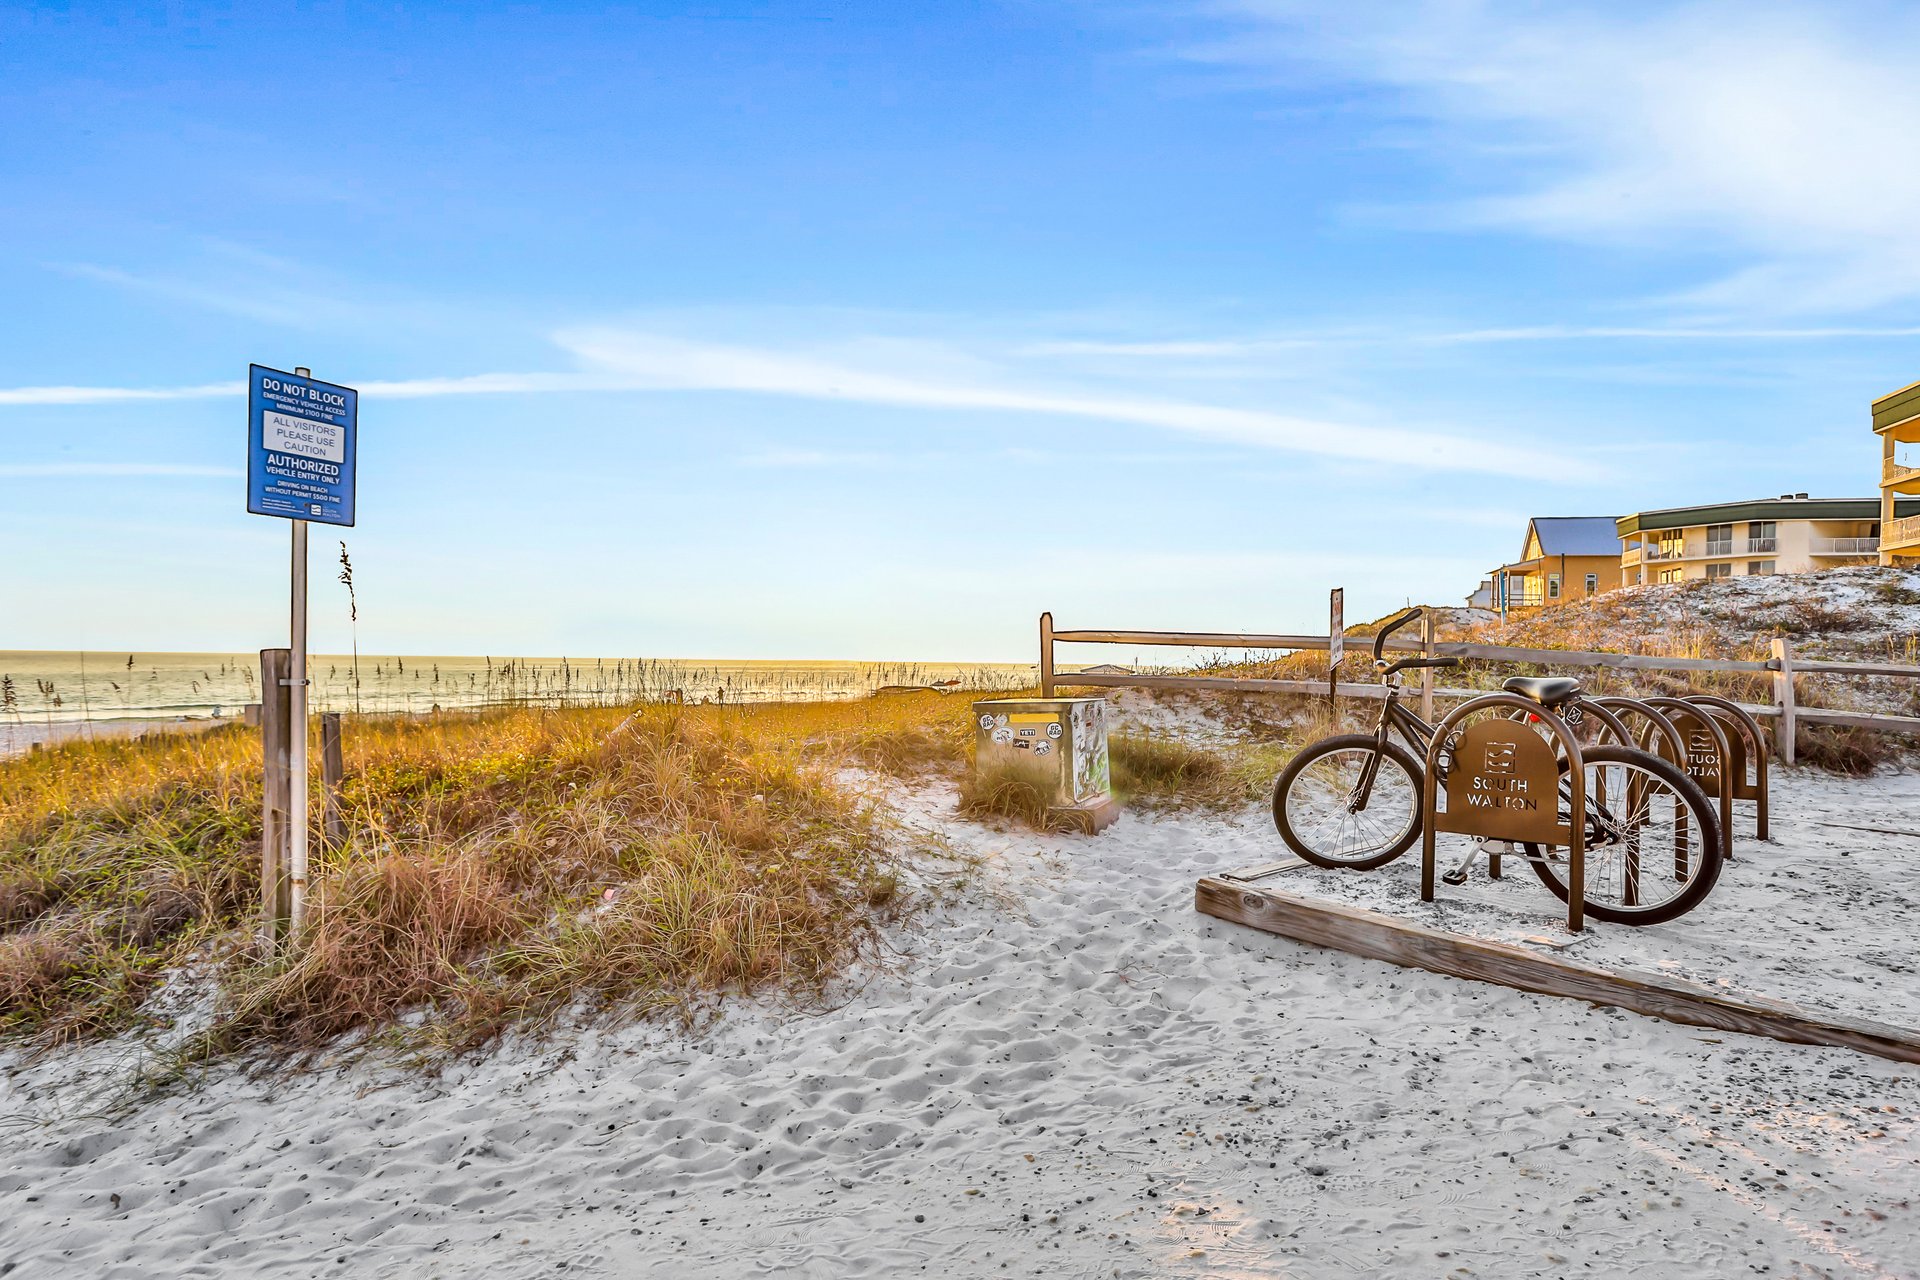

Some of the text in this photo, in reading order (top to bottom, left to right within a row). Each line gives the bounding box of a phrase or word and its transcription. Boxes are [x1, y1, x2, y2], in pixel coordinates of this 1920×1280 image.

[263, 378, 345, 407] DO NOT BLOCK
[263, 392, 346, 416] EMERGENCY VEHICLE ACCESS
[276, 403, 304, 414] MINIMUM
[321, 413, 333, 421] FINE
[273, 417, 336, 437] ALL VISITORS
[277, 428, 335, 448] PLEASE USE
[284, 441, 326, 456] CAUTION
[267, 454, 339, 476] AUTHORIZED
[265, 465, 340, 485] VEHICLE ENTRY ONLY
[265, 486, 291, 495] WITHOUT
[292, 489, 312, 498] PERMIT
[329, 496, 341, 504] FINE
[277, 480, 300, 489] DRIVING
[310, 485, 328, 494] BEACH
[1473, 776, 1528, 793] SOUTH
[1466, 793, 1537, 811] WALTON
